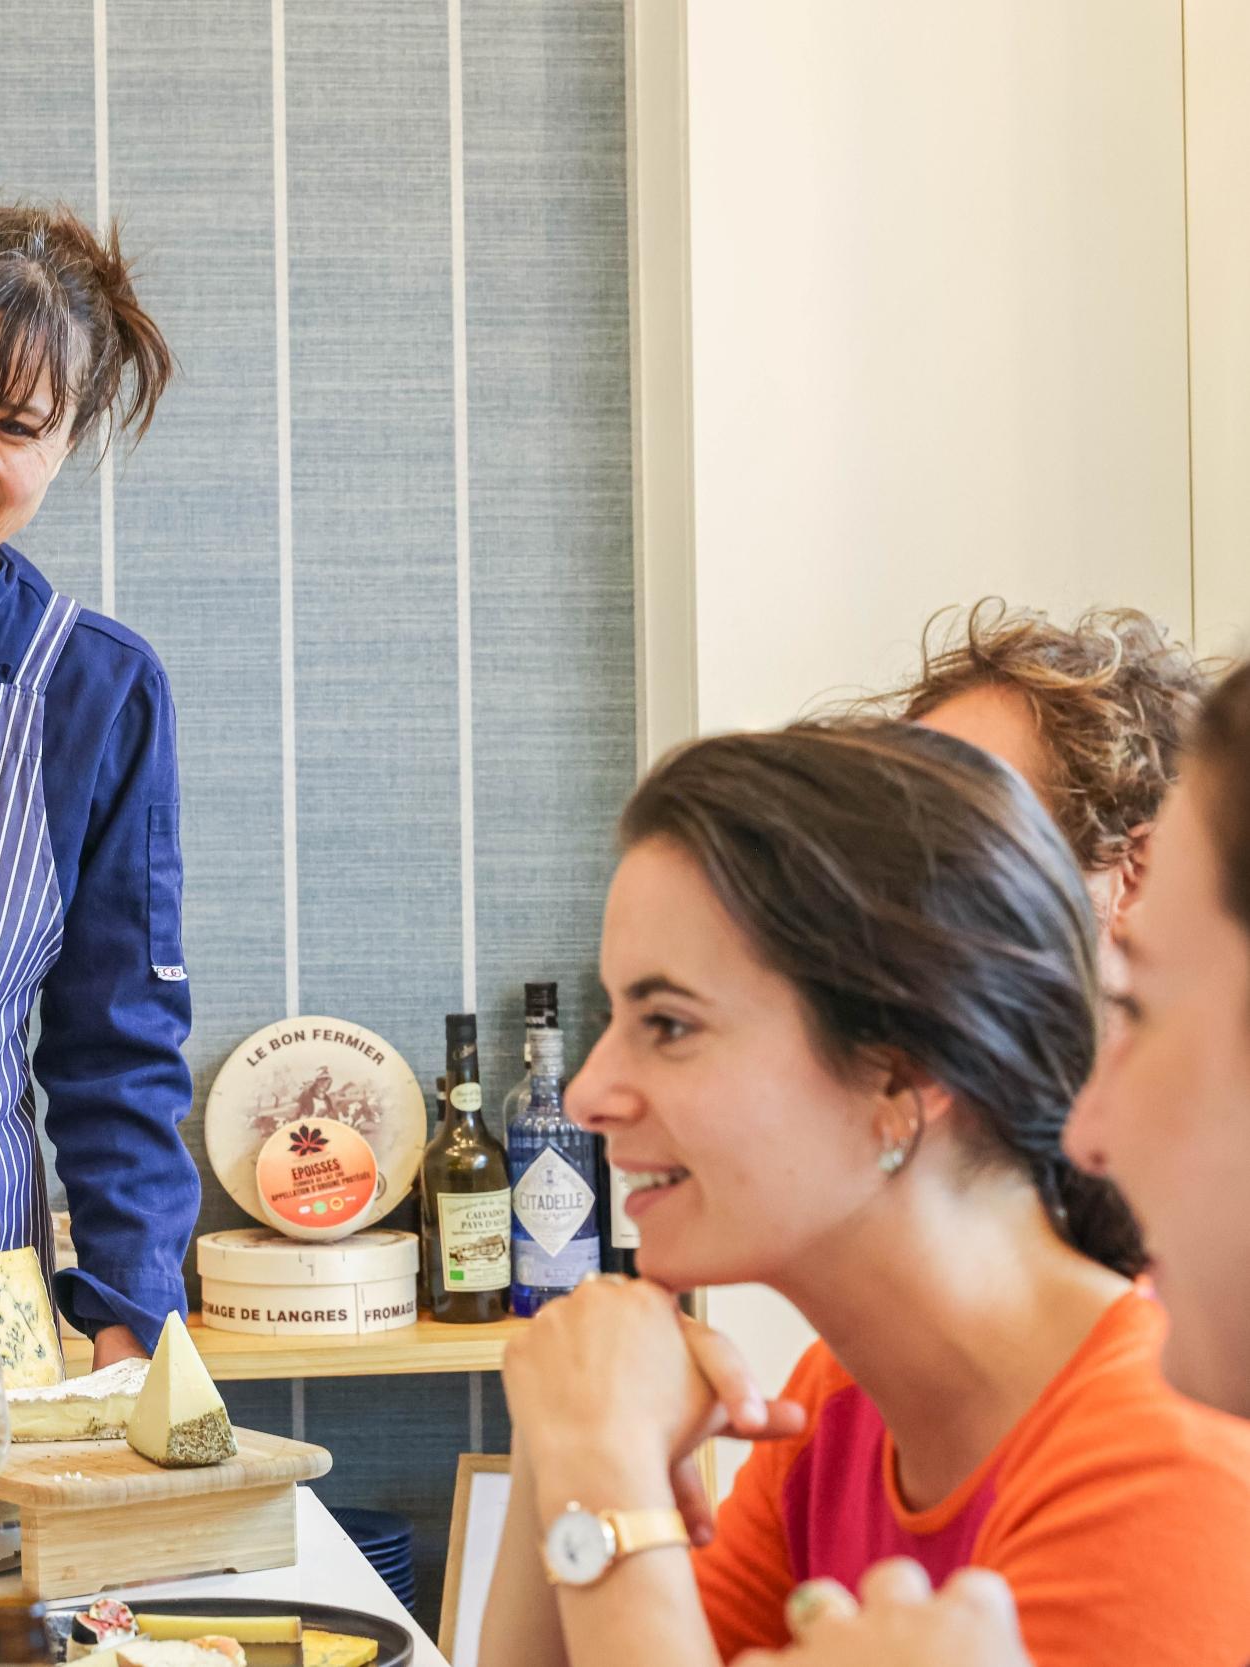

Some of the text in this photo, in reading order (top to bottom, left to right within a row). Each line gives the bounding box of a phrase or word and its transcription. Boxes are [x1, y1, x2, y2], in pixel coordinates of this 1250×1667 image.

[246, 1028, 386, 1067] LE BON FERMIER
[291, 1158, 341, 1181] EPOISSES
[519, 1192, 583, 1211] CITADELLE
[240, 1309, 261, 1322] DE
[267, 1308, 349, 1323] LANGRES
